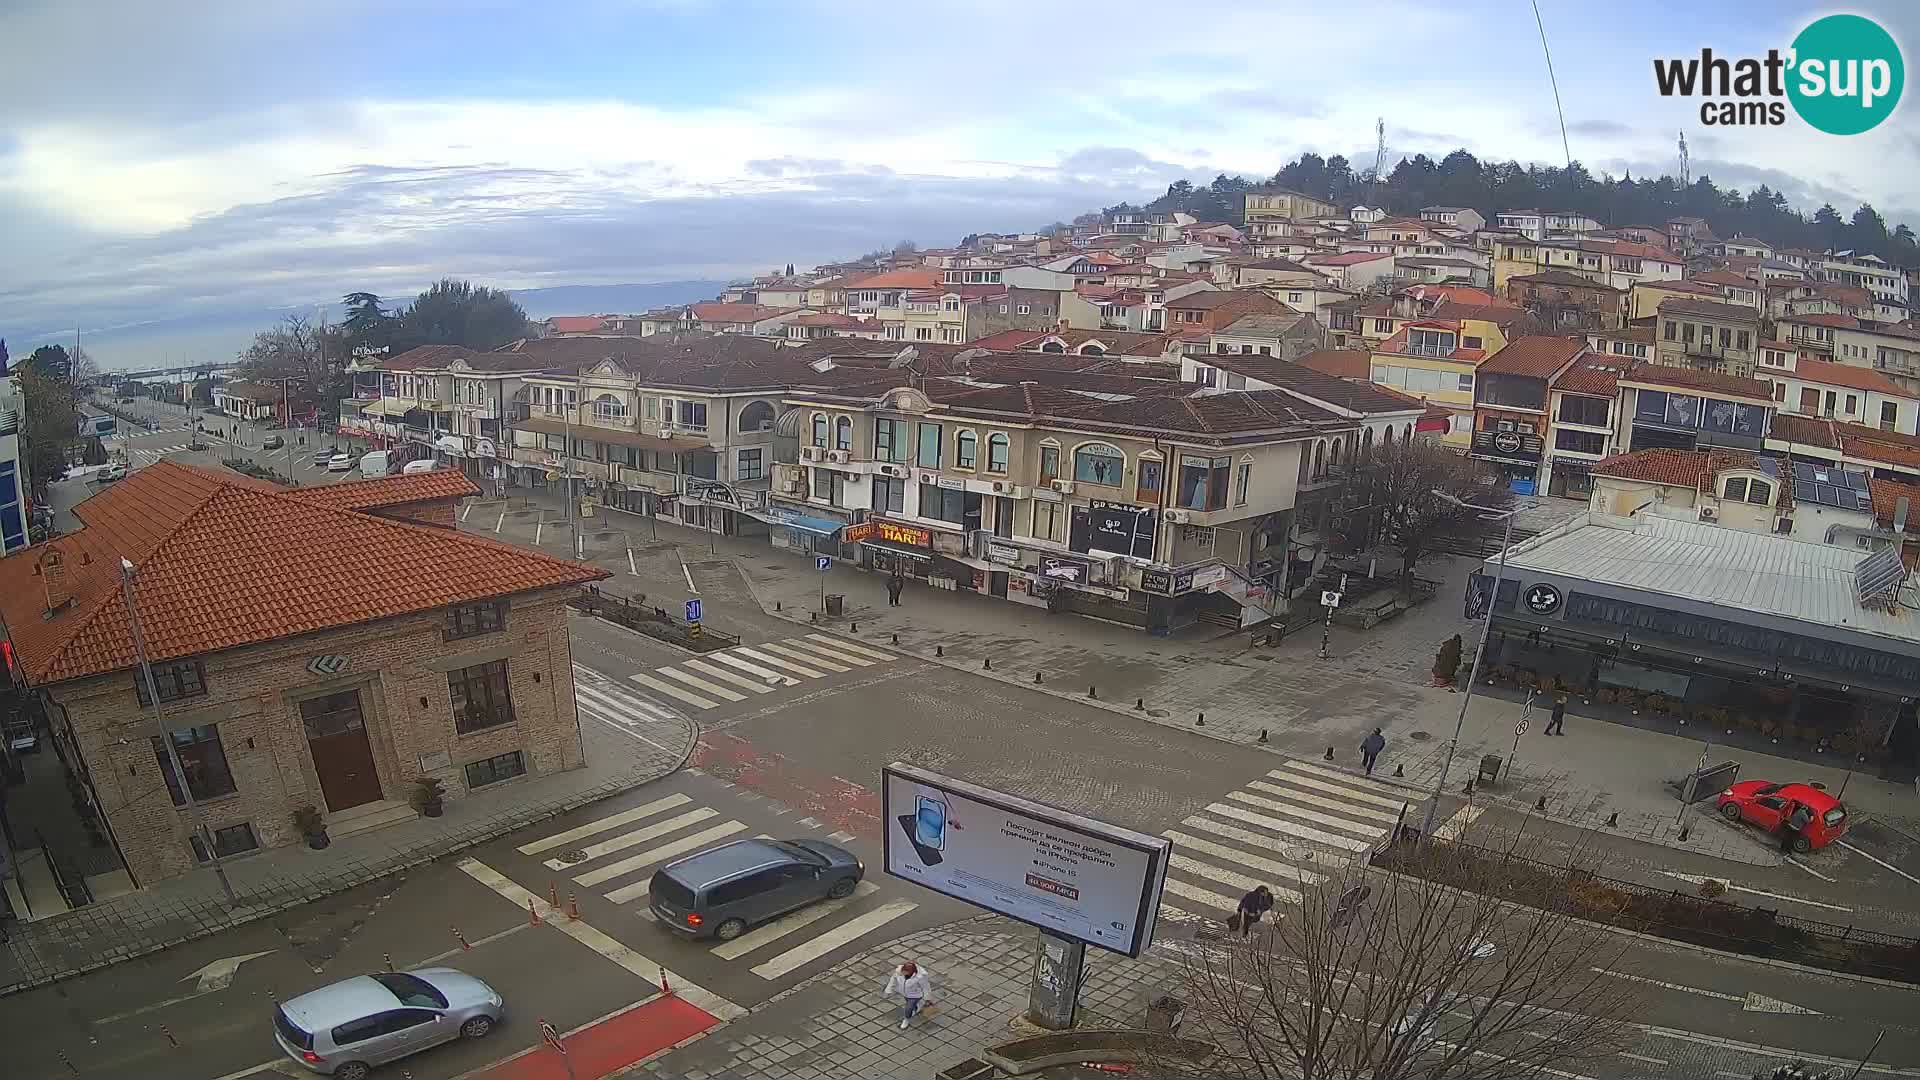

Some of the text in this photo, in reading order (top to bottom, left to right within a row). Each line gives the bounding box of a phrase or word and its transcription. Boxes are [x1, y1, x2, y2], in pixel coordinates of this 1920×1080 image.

[884, 530, 916, 545] HARI
[820, 559, 827, 569] P
[1048, 850, 1078, 865] iPhone
[1082, 843, 1111, 858] добри
[1039, 860, 1066, 873] iPhone
